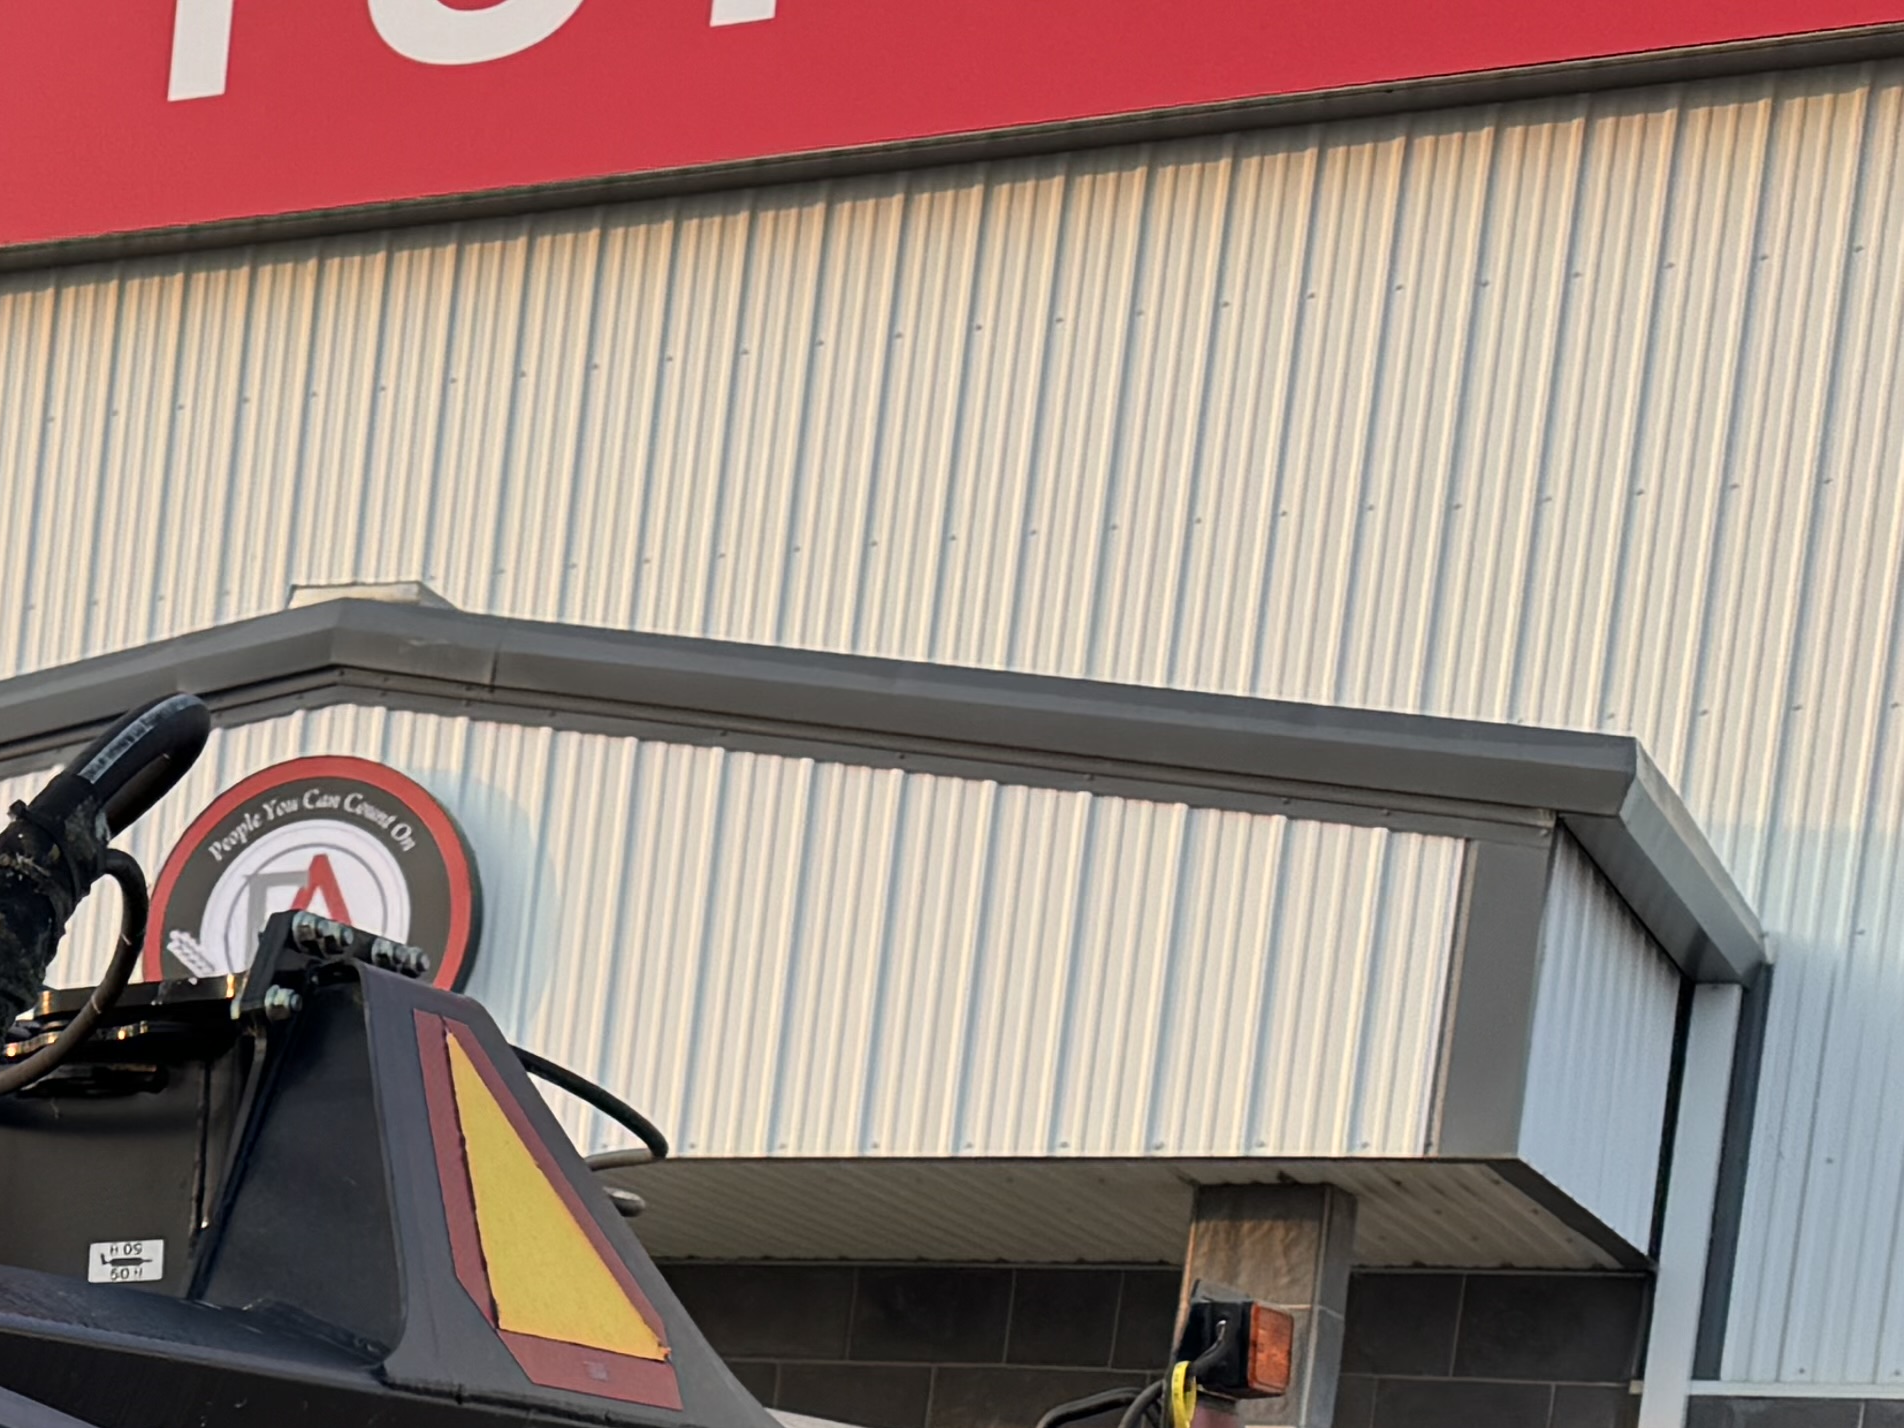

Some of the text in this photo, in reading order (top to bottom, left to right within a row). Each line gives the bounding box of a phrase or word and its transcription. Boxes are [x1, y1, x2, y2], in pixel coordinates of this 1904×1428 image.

[208, 789, 417, 862] People You Can Count On
